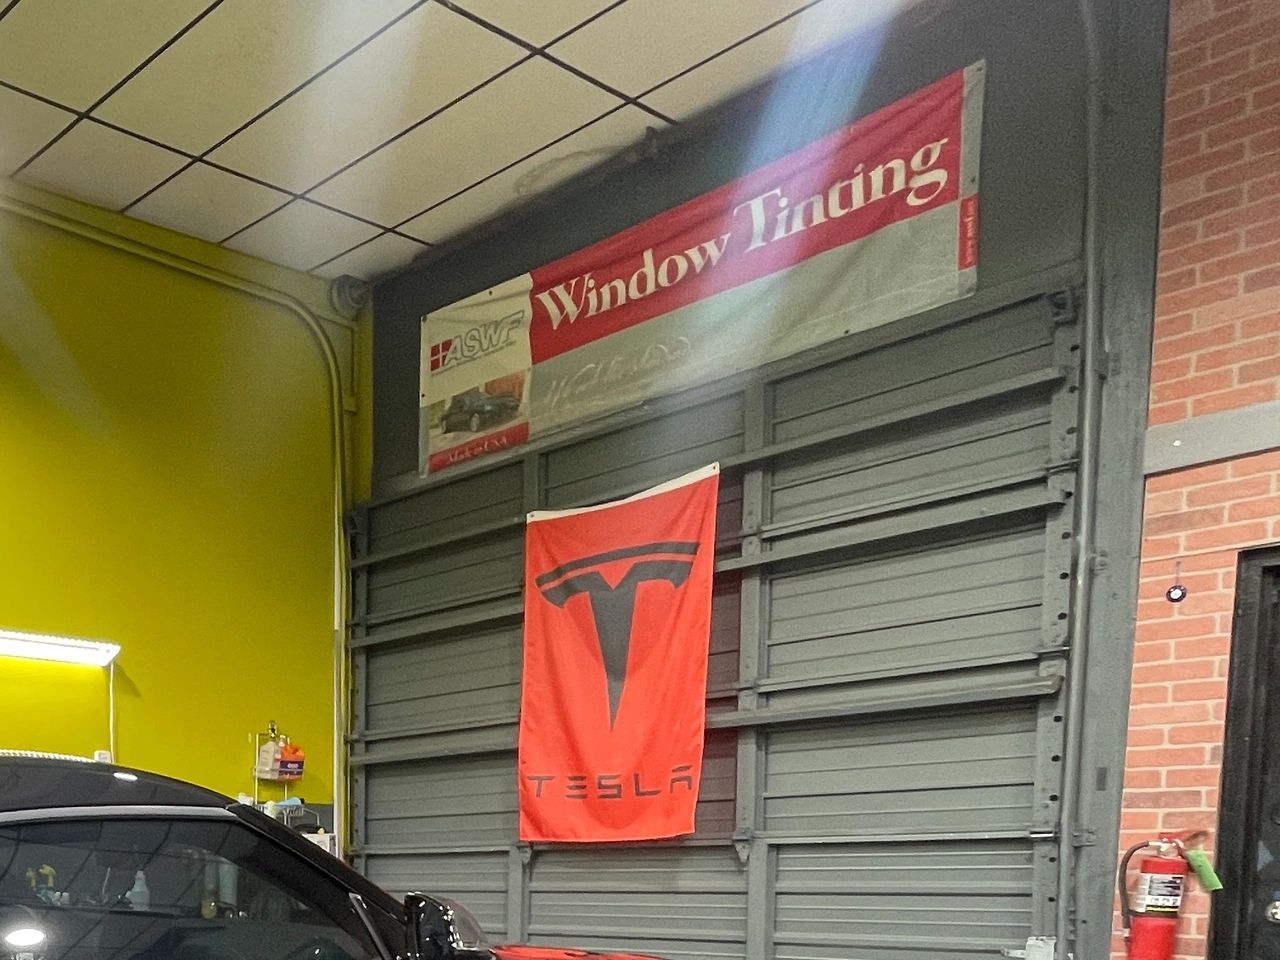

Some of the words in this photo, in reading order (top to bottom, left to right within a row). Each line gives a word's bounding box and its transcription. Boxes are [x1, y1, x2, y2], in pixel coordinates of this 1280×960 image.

[535, 232, 732, 331] Window
[733, 137, 950, 255] Tinting
[443, 310, 525, 367] ASWF
[527, 765, 693, 800] TESLA
